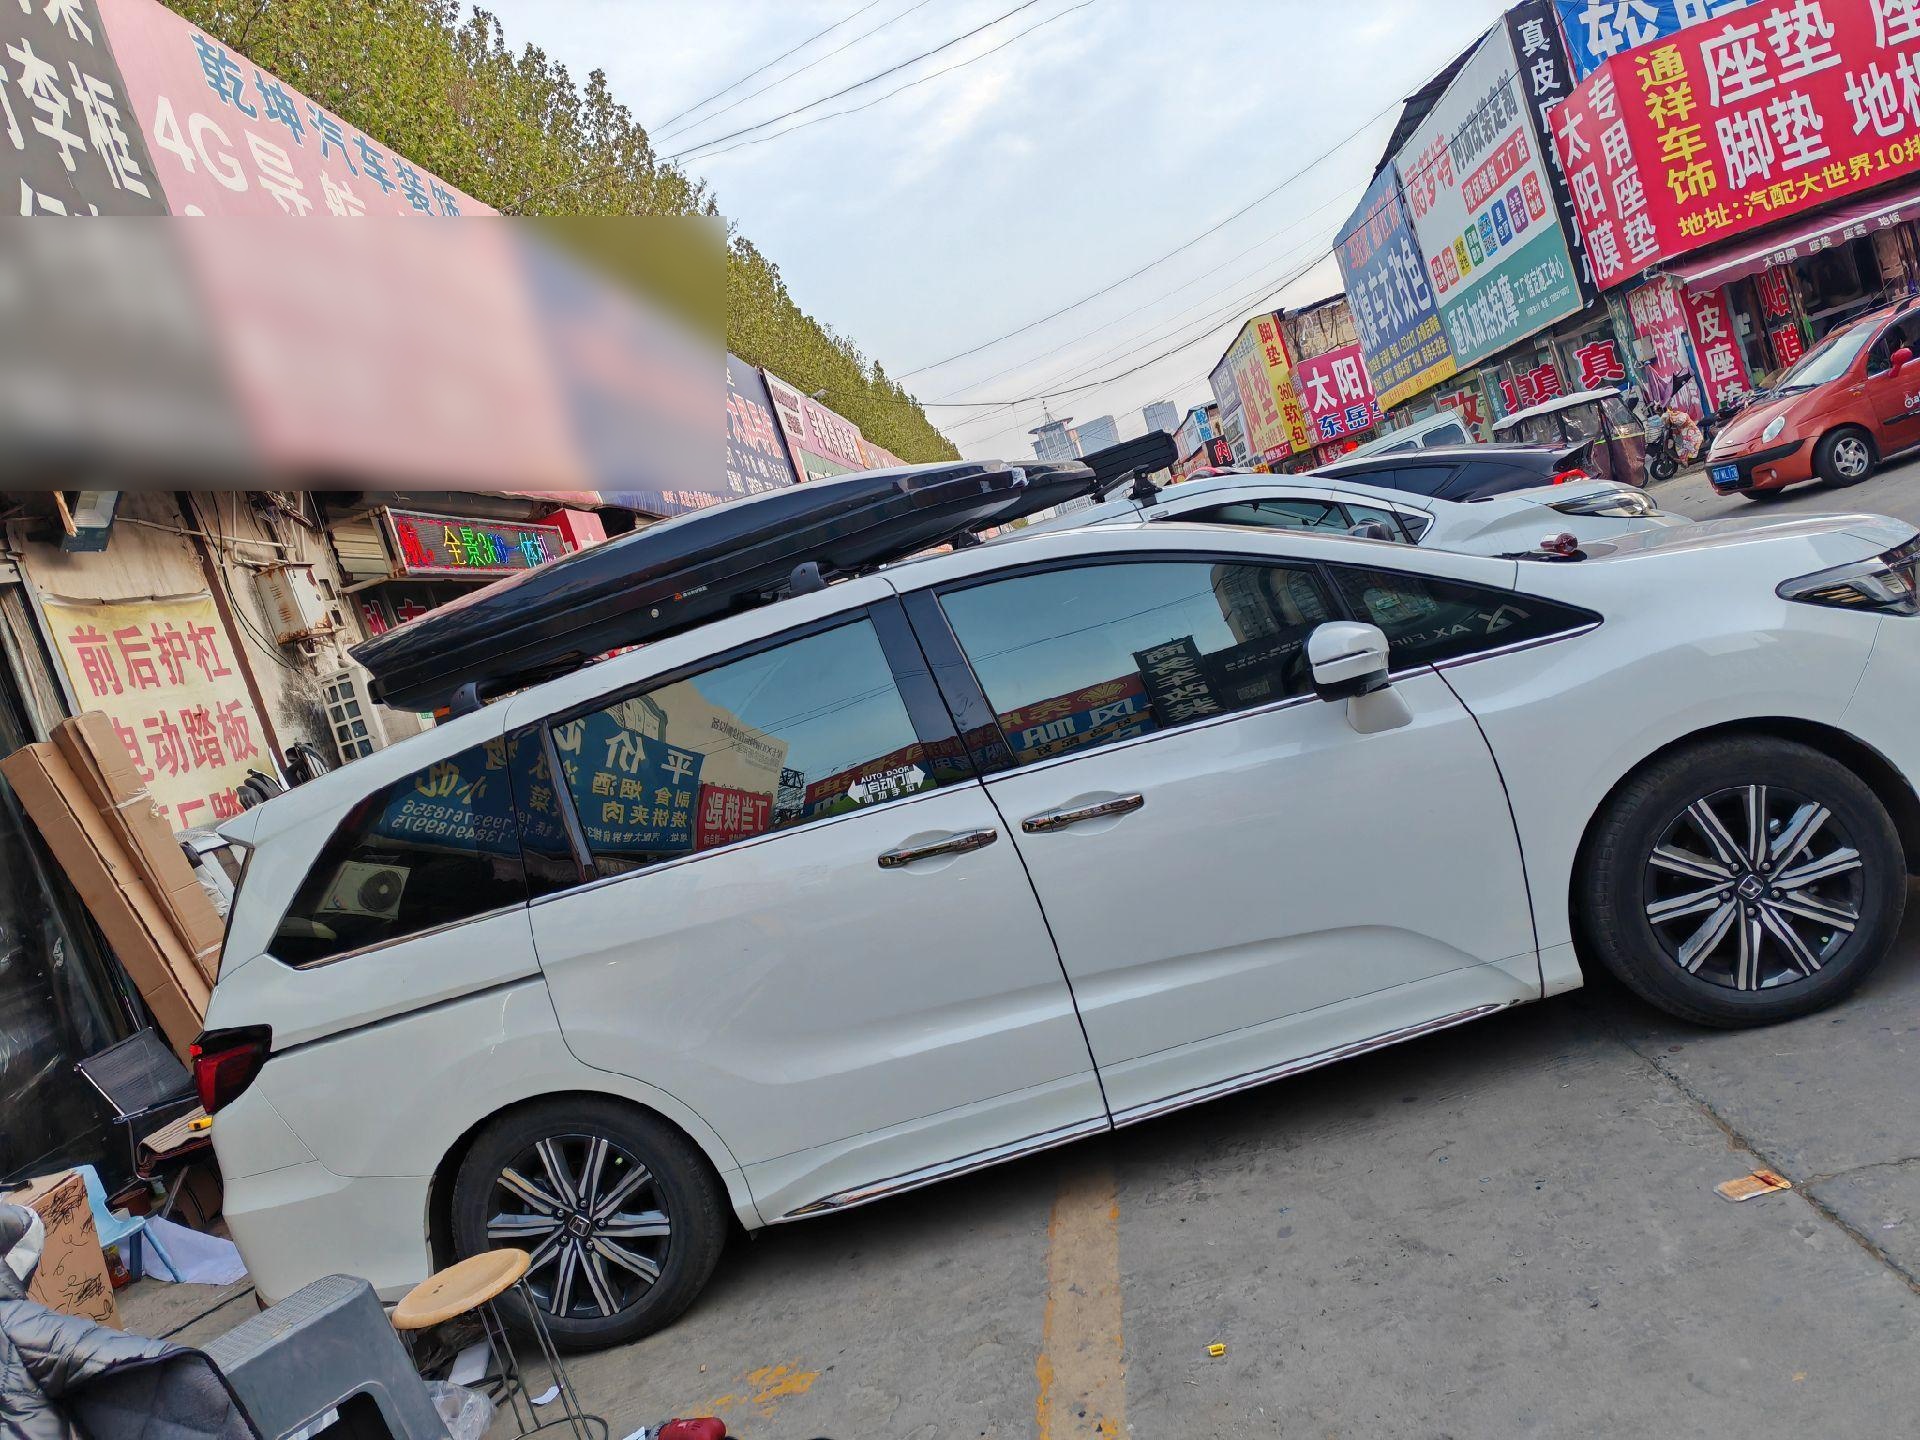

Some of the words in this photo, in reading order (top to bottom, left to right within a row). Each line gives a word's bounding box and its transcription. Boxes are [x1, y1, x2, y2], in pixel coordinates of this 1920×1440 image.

[1700, 0, 1841, 108] 座垫
[1588, 73, 1660, 264] 专用座垫
[1635, 44, 1718, 206] 通祥车饰
[1715, 90, 1830, 190] 脚垫
[1558, 107, 1624, 282] 太阳膜
[1878, 214, 1901, 227] 地板
[1306, 353, 1374, 413] 太阳
[67, 620, 232, 697] 前后护杠
[861, 773, 882, 784] AUTO
